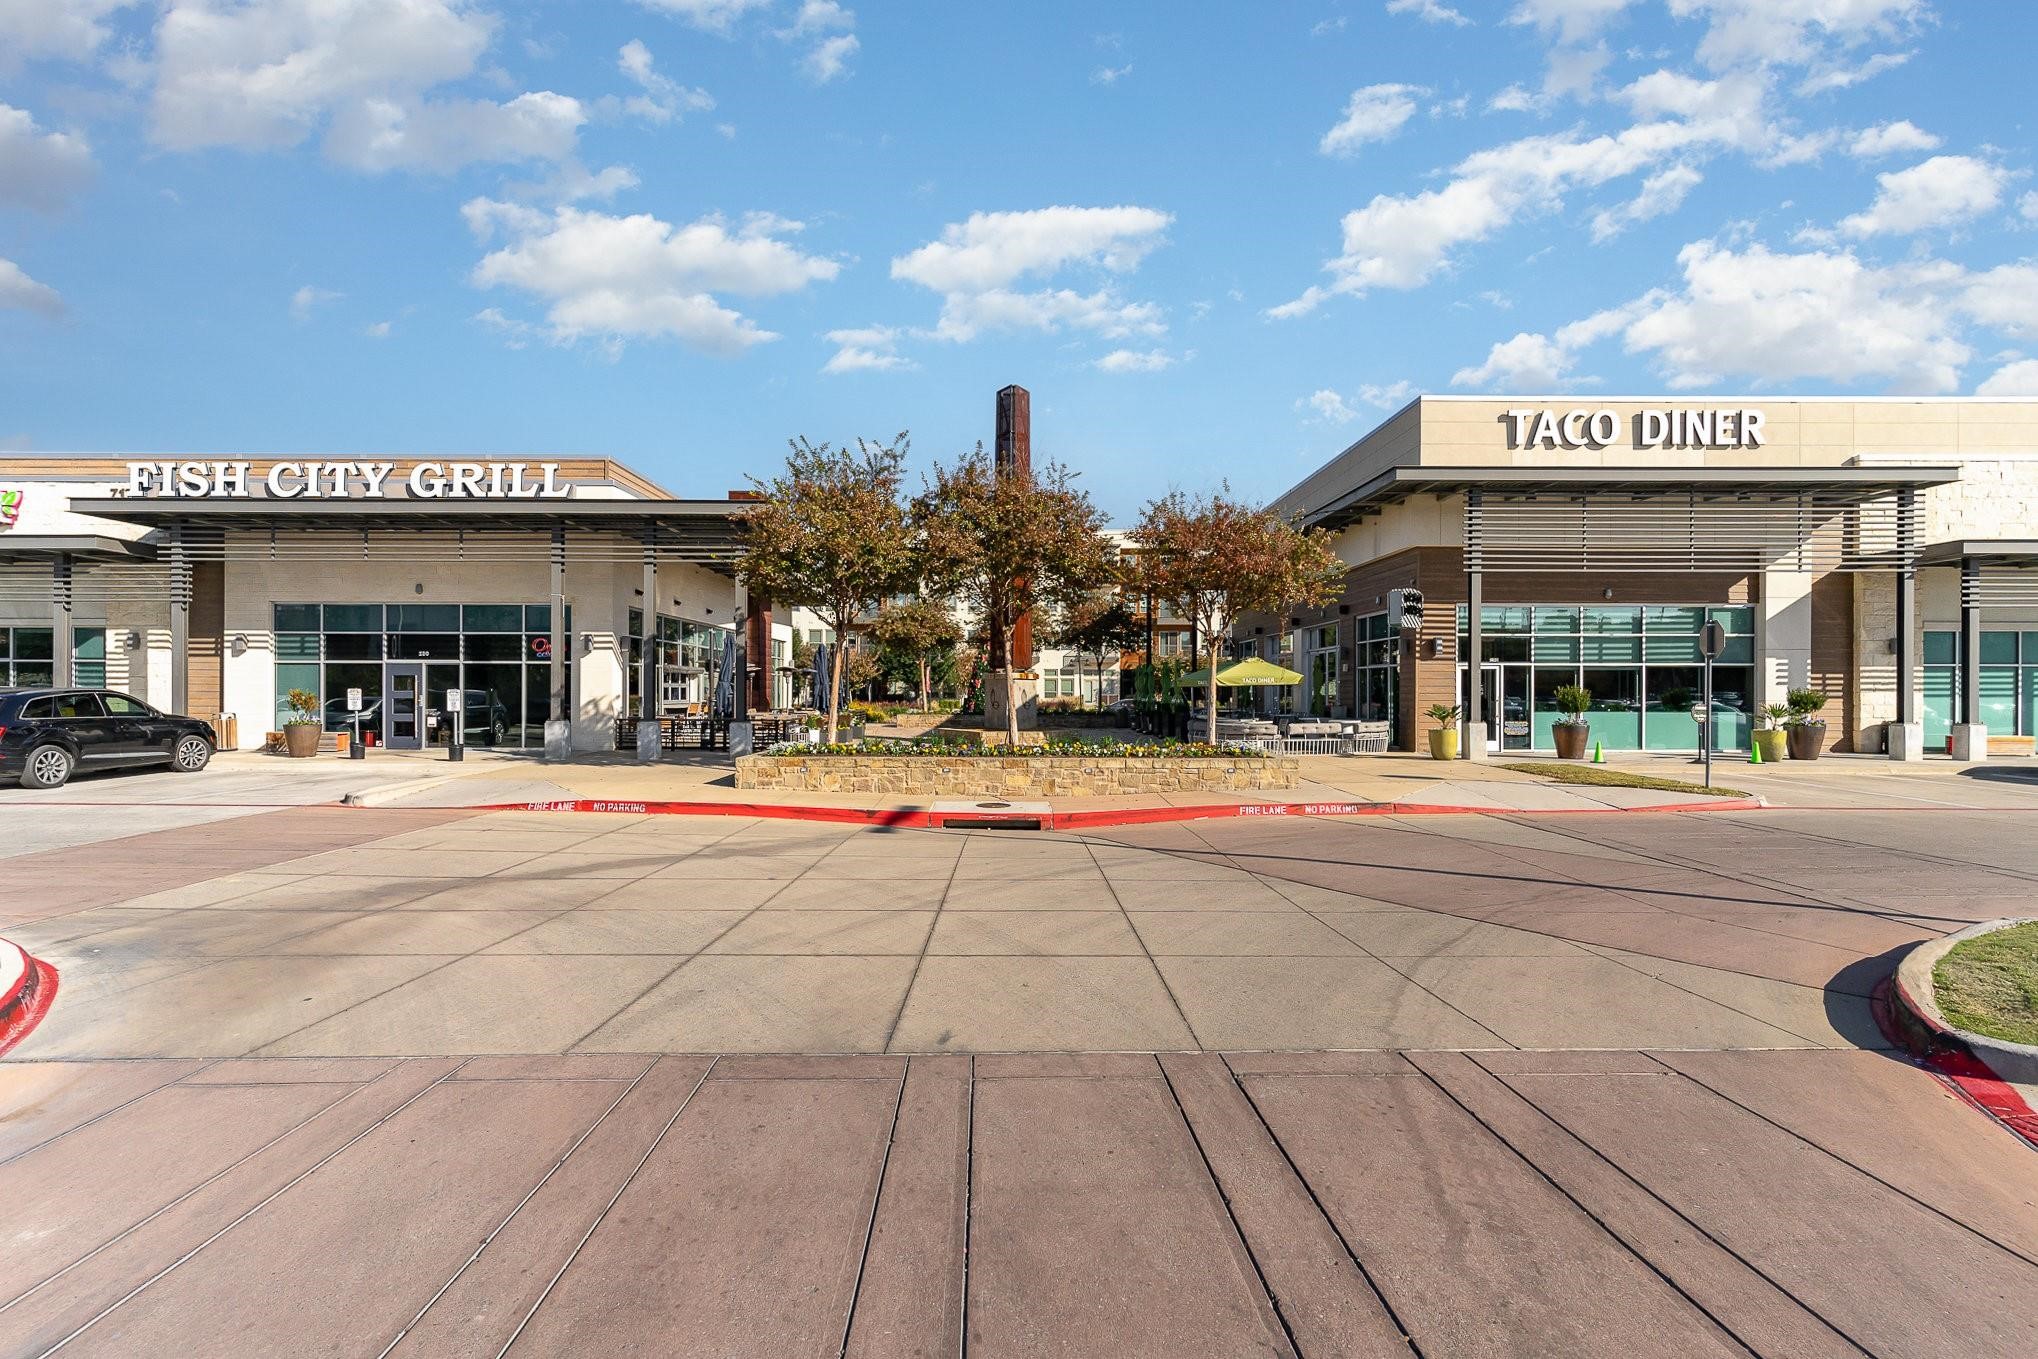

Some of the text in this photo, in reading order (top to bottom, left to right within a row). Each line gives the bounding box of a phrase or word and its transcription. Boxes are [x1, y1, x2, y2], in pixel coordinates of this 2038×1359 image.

[1507, 409, 1767, 446] TACO DINER
[126, 461, 571, 498] FISH CITY GRILL
[110, 488, 130, 498] 71
[528, 801, 646, 812] FIRE LANE NO PARKING
[1240, 804, 1358, 816] FIRE LANE NO PARKING
